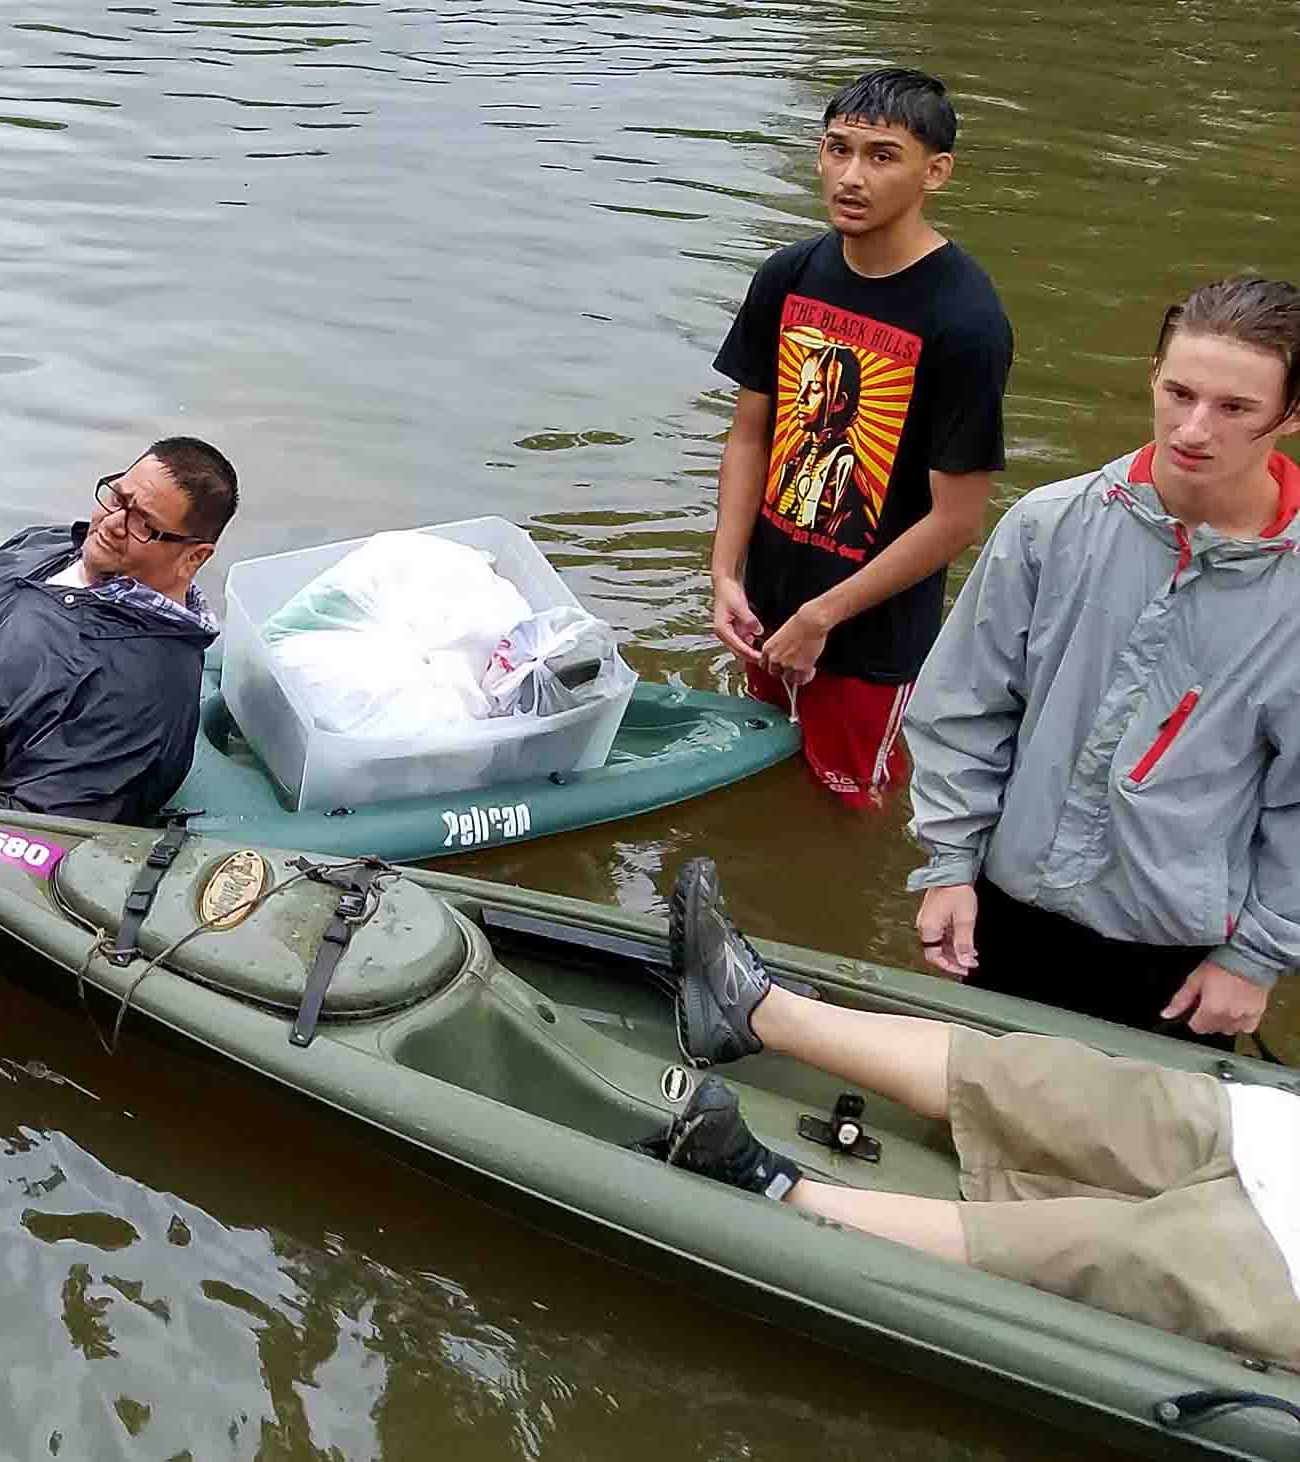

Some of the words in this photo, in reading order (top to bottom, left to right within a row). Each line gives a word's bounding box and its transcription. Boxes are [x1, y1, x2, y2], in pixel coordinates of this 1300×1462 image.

[790, 302, 817, 322] THE
[820, 309, 868, 340] BLACK
[871, 327, 915, 359] HILLS
[442, 803, 531, 847] Pelican
